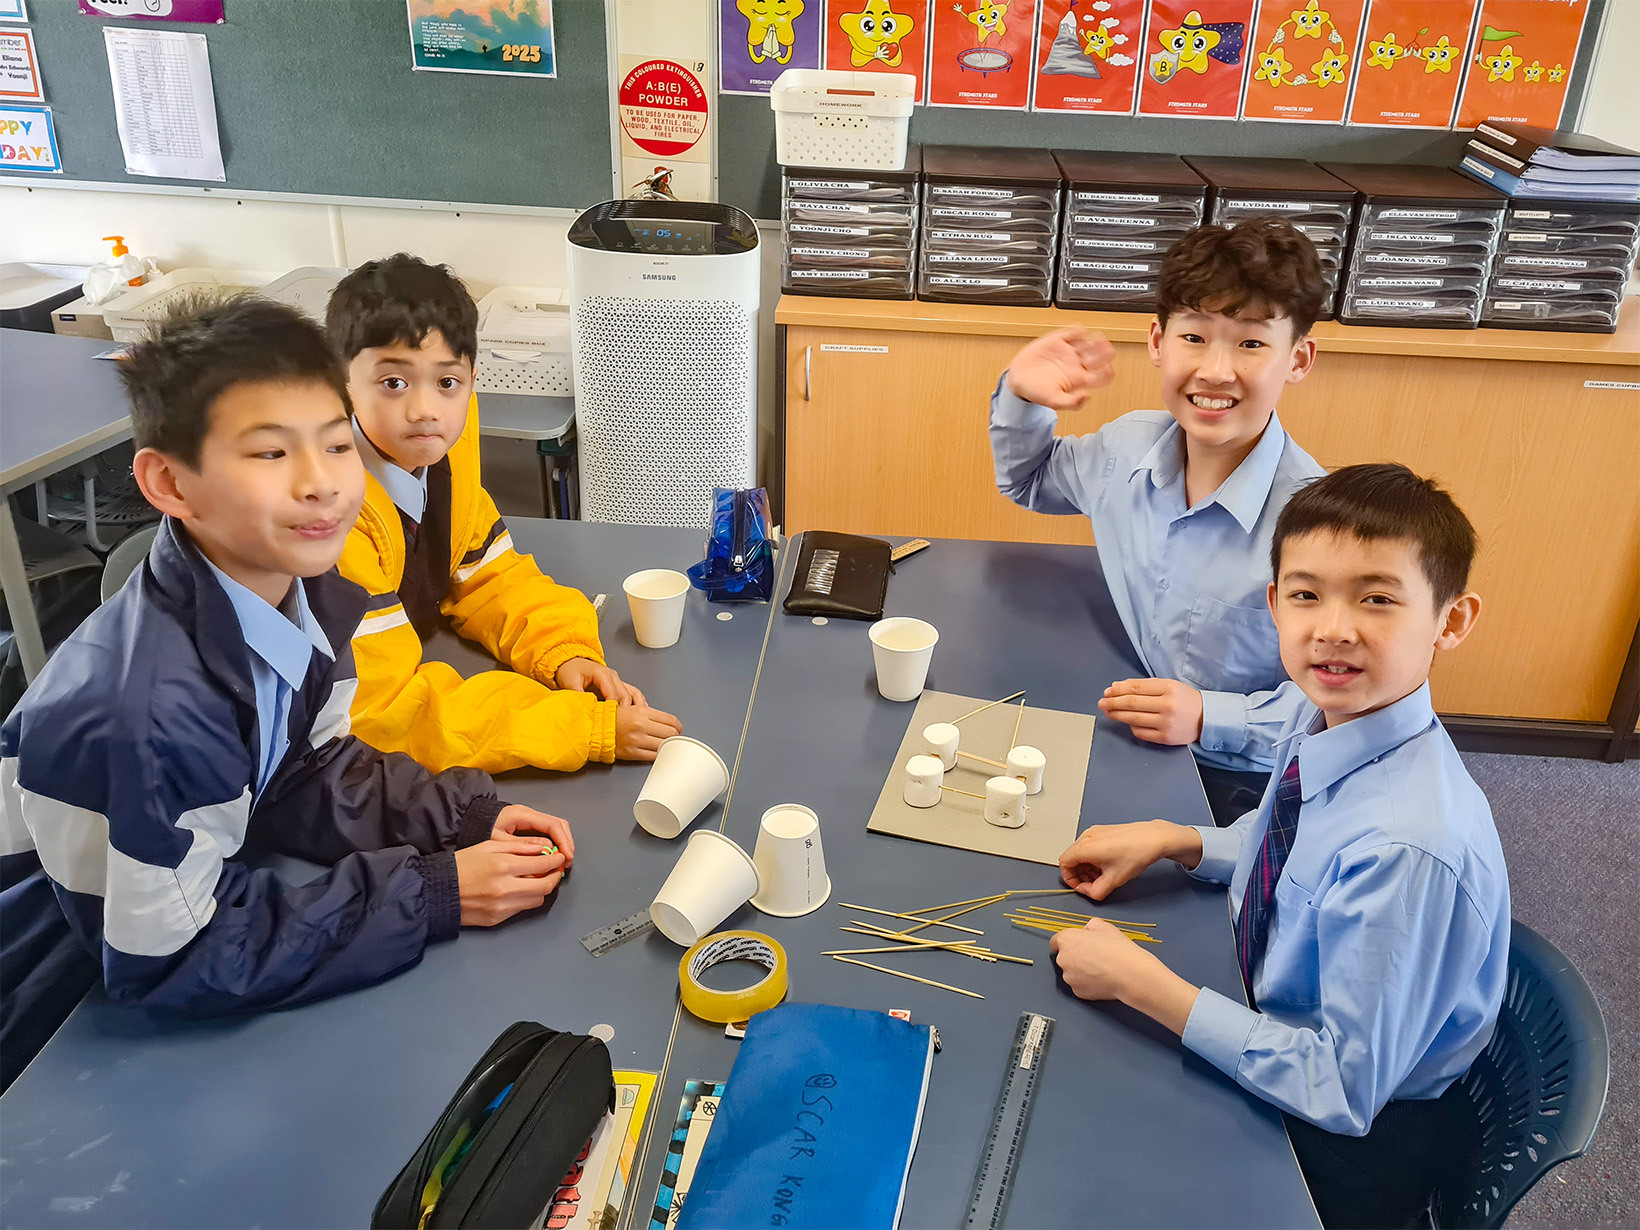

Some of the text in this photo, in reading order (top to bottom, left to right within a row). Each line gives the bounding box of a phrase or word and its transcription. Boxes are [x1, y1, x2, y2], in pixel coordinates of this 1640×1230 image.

[2, 54, 22, 62] Eliana
[502, 44, 542, 63] 2025
[1160, 60, 1168, 72] B
[7, 72, 28, 80] Yoonji
[624, 63, 702, 99] THIS COLOURED EXTINGUISHER
[646, 80, 682, 94] A:B(E)
[638, 94, 688, 107] POWDER
[645, 110, 662, 118] USED
[664, 124, 700, 135] ELECTRICAL
[770, 1174, 805, 1228] KONG
